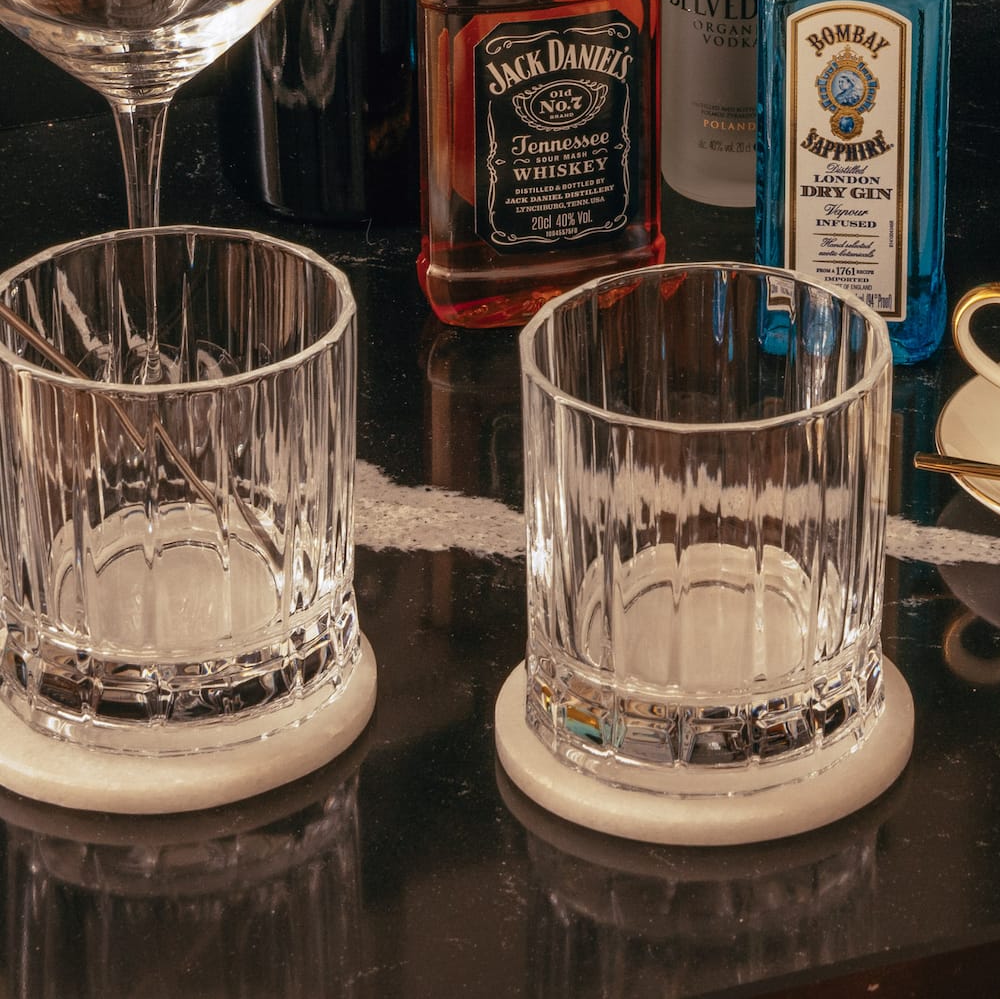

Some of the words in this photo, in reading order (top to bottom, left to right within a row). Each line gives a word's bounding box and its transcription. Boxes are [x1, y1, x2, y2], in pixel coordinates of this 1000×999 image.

[692, 19, 757, 35] ORGAN
[806, 23, 892, 59] BOMBAY
[485, 49, 547, 95] JACK
[547, 38, 633, 80] DANIEL'S
[550, 88, 572, 99] Old
[549, 112, 575, 120] BRAND
[703, 119, 756, 131] POLAND
[511, 131, 610, 156] Tennessee
[800, 127, 892, 163] SAPPHIRE
[535, 154, 560, 164] SOUR
[563, 151, 588, 161] MASH
[513, 156, 609, 181] WHISKEY
[825, 163, 868, 175] Distilled
[515, 185, 554, 195] DISTILLED
[562, 179, 595, 190] BOTTLED
[814, 174, 881, 185] LONDON
[505, 195, 528, 205] JACK
[530, 193, 563, 203] DANIEL
[565, 184, 615, 199] DISTILLERY
[799, 185, 847, 199] DRY
[850, 187, 894, 200] GIN
[824, 203, 869, 219] Vapour
[531, 214, 552, 231] 20cl
[555, 211, 576, 228] 40%
[577, 209, 593, 225] Vol.
[815, 218, 878, 229] INFUSED
[836, 266, 856, 276] 1761
